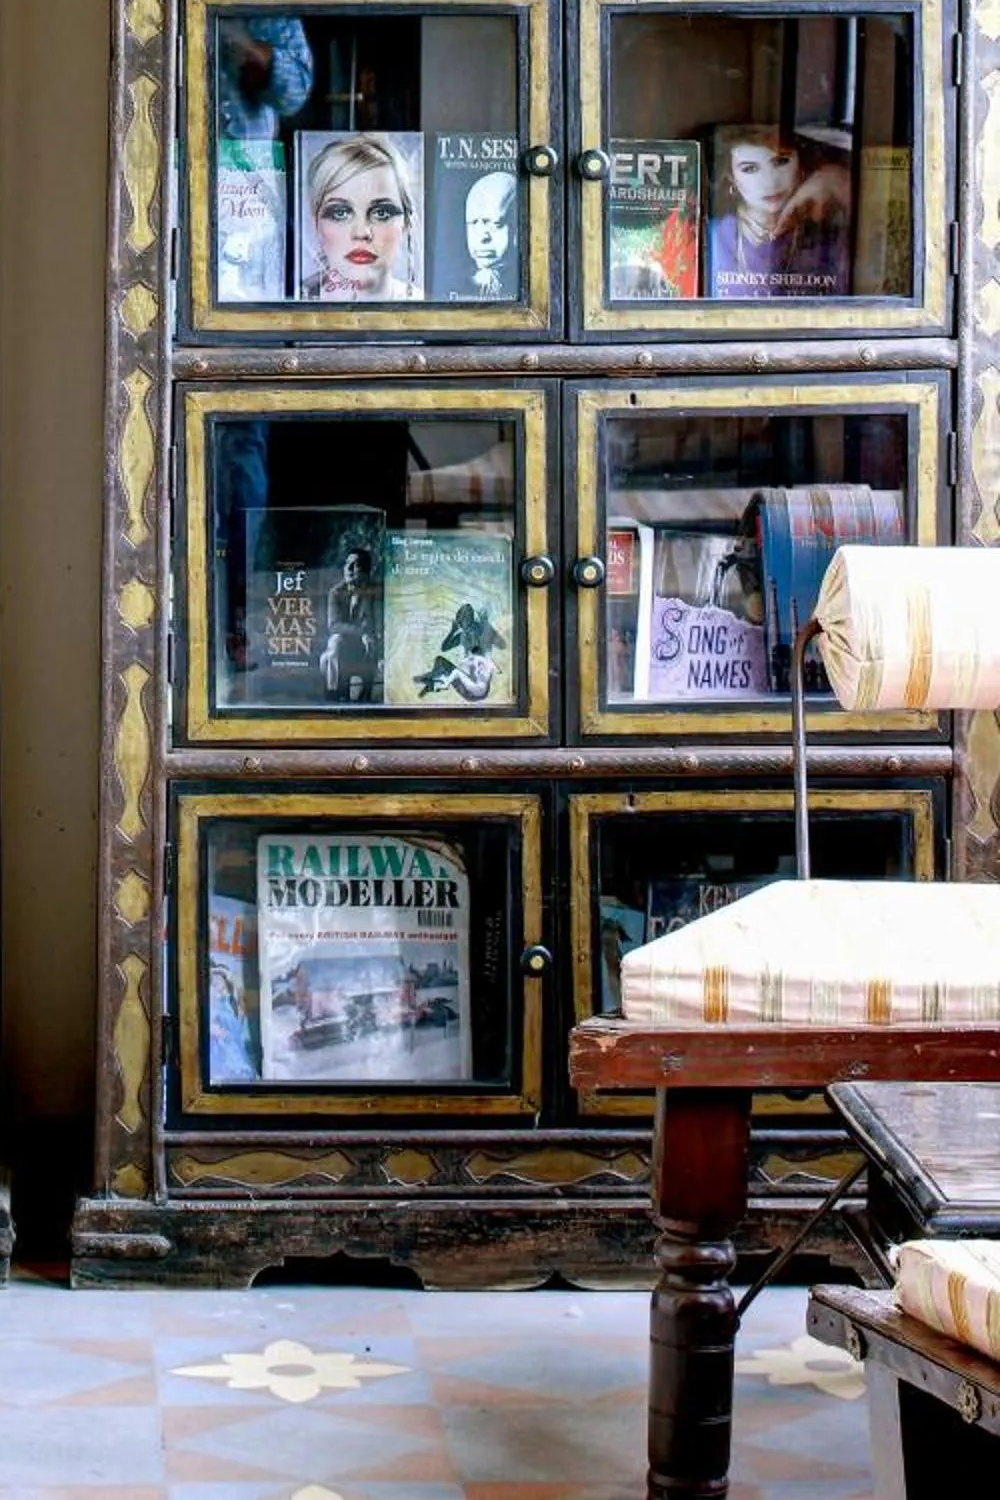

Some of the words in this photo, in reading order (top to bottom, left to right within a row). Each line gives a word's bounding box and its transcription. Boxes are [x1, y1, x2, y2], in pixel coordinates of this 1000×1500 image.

[438, 137, 454, 159] T.
[458, 138, 477, 159] N.
[716, 272, 769, 285] SIDNEY
[770, 273, 837, 287] SHELDON
[275, 571, 306, 597] Jef
[267, 597, 313, 616] VER
[264, 617, 317, 637] MAS
[656, 607, 728, 661] SONG
[268, 637, 313, 656] SEN
[687, 659, 752, 689] NAMES
[266, 845, 449, 878] RAILWA
[267, 879, 460, 908] MODELLER
